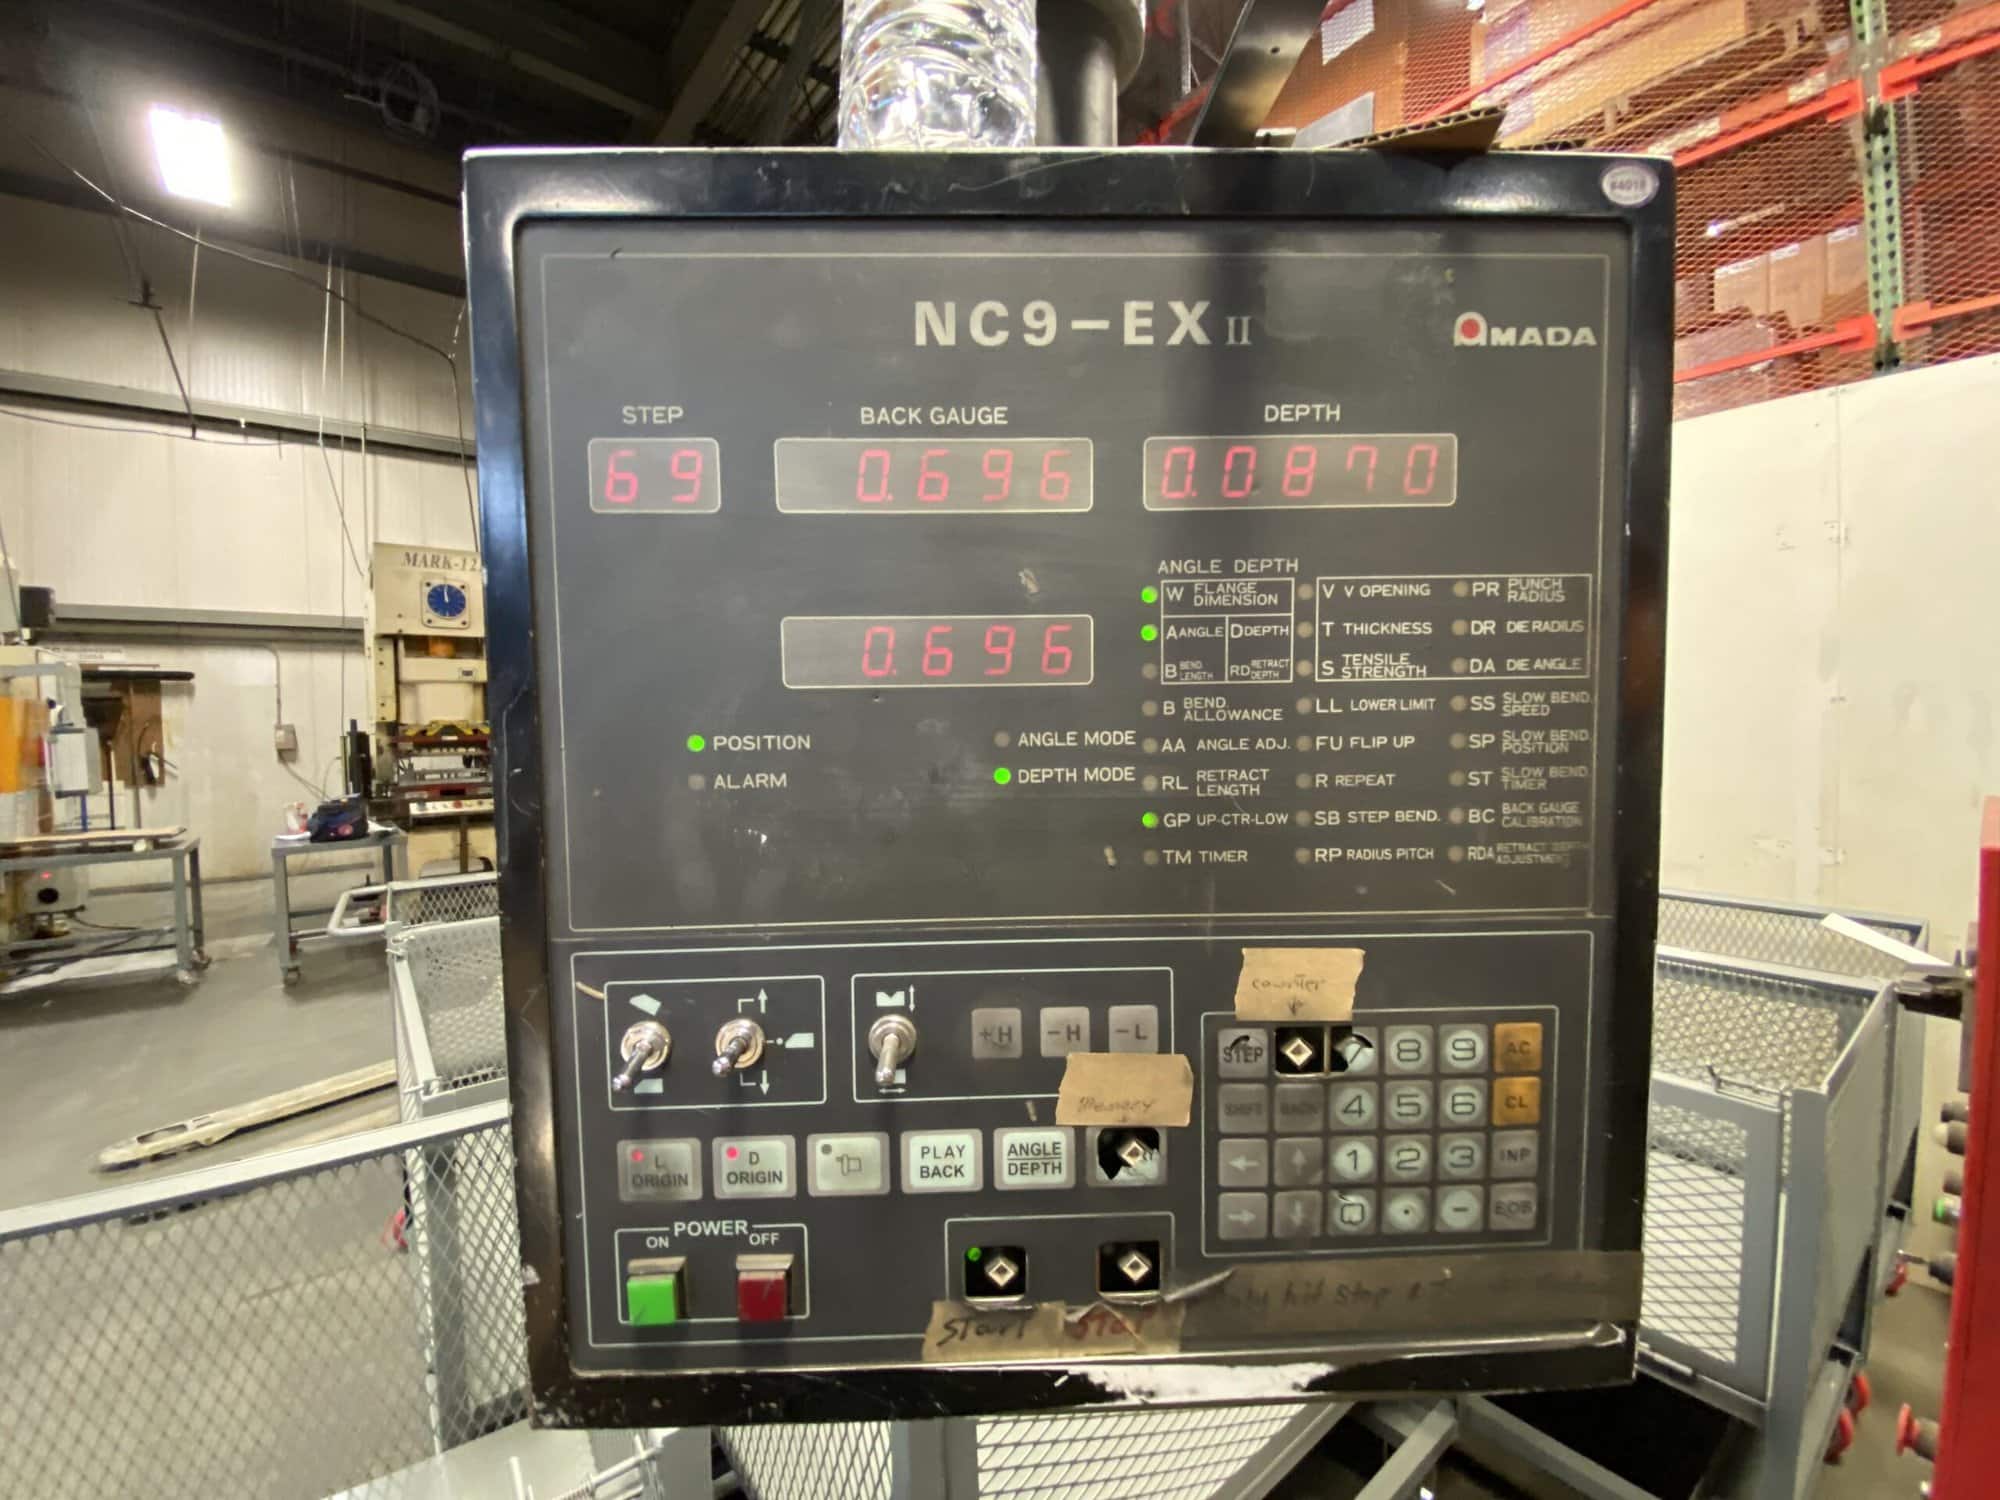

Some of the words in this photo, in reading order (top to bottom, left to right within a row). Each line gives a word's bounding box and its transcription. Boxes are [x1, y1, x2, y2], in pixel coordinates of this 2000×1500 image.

[1225, 316, 1252, 345] II
[1454, 311, 1597, 347] AMADA
[622, 405, 684, 424] STEP
[860, 406, 922, 425] BACK
[930, 406, 1008, 425] GAUGE
[1264, 403, 1341, 422] DEPTH
[605, 449, 703, 503] 69
[856, 448, 1072, 503] 0.696
[1161, 444, 1439, 498] 0.0870
[400, 551, 482, 572] MARK-12
[1158, 560, 1222, 574] ANGLE
[1234, 559, 1299, 573] DEPTH
[1166, 587, 1184, 601] W
[1194, 582, 1257, 594] FLANGE
[1322, 584, 1335, 599] V
[1360, 584, 1431, 598] OPENING
[1472, 582, 1500, 597] PR
[1508, 578, 1562, 590] PUNCH
[1194, 594, 1278, 606] DIMENSION
[1507, 590, 1565, 602] RADIUS
[1166, 625, 1178, 639] A
[1179, 626, 1224, 637] ANGLE
[1230, 624, 1243, 638] D
[1244, 625, 1289, 637] DEPTH
[1321, 622, 1335, 637] T
[1343, 622, 1433, 635] THICKNESS
[1471, 620, 1496, 635] DR
[1506, 621, 1529, 633] DIE
[1531, 620, 1584, 632] RADIUS
[861, 625, 1073, 677] 0.696
[1342, 653, 1411, 665] TENSILE
[1469, 659, 1496, 673] DA
[1506, 659, 1530, 671] DIE
[1533, 658, 1582, 670] ANGLE
[1165, 664, 1177, 679] B
[1180, 661, 1203, 670] BEND
[1230, 664, 1250, 677] RD
[1250, 659, 1290, 669] RETRACT
[1251, 670, 1279, 680] DEPTH
[1322, 660, 1334, 675] S
[1342, 665, 1427, 679] STRENGTH
[1180, 671, 1213, 681] LENGTH
[1163, 701, 1175, 715] B
[1184, 697, 1226, 709] BEND
[1316, 698, 1343, 713] LL
[1350, 698, 1396, 711] LOWER
[1400, 698, 1436, 711] LIMIT
[1470, 696, 1496, 711] SS
[1502, 692, 1546, 705] SLOW
[1184, 709, 1283, 721] ALLOWANCE
[1502, 705, 1550, 717] SPEED
[713, 735, 811, 751] POSITION
[1018, 732, 1078, 747] ANGLE
[1083, 730, 1137, 746] MODE
[1161, 738, 1186, 752] AA
[1196, 738, 1249, 750] ANGLE
[1255, 738, 1291, 750] ADJ.
[1315, 736, 1343, 751] FU
[1350, 736, 1388, 749] FLIP
[1393, 735, 1415, 748] UP
[1469, 734, 1496, 749] SP
[1502, 730, 1545, 742] SLOW
[1502, 742, 1569, 754] POSITION
[714, 773, 787, 789] ALARM
[1018, 768, 1077, 783] DEPTH
[1083, 767, 1136, 782] MODE
[1162, 776, 1188, 790] RL
[1197, 769, 1270, 782] RETRACT
[1315, 773, 1328, 788] R
[1335, 773, 1396, 787] REPEAT
[1468, 771, 1494, 786] ST
[1501, 767, 1544, 779] SLOW
[1197, 784, 1260, 797] LENGTH
[1501, 779, 1547, 791] TIMER
[1314, 811, 1340, 826] SB
[1347, 810, 1390, 823] STEP
[1468, 809, 1495, 823] BC
[1502, 802, 1534, 815] BACK
[1539, 801, 1580, 814] GAUGE
[1163, 813, 1191, 828] GP
[1502, 816, 1582, 828] CALIBRATION
[1163, 849, 1192, 864] TM
[1199, 850, 1248, 863] TIMER
[1315, 848, 1342, 863] RP
[1347, 849, 1392, 861] RADIUS
[1396, 848, 1434, 860] PITCH
[1468, 846, 1495, 860] RDA
[1223, 1045, 1263, 1063] STEP
[1397, 1039, 1421, 1062] 8
[1452, 1038, 1476, 1061] 9
[1506, 1041, 1530, 1056] AC
[1342, 1095, 1364, 1117] 4
[1397, 1094, 1421, 1116] 5
[1451, 1092, 1476, 1115] 6
[1505, 1095, 1528, 1109] CL
[921, 1145, 965, 1159] PLAY
[1008, 1142, 1061, 1157] ANGLE
[1450, 1146, 1474, 1168] 3
[654, 1155, 664, 1169] L
[749, 1151, 759, 1165] D
[1346, 1149, 1358, 1170] 1
[1396, 1148, 1420, 1170] 2
[920, 1164, 965, 1179] BACK
[1008, 1161, 1062, 1176] DEPTH
[631, 1173, 688, 1188] ORIGIN
[727, 1171, 783, 1185] ORIGIN
[674, 1220, 748, 1237] POWER
[646, 1236, 669, 1249] ON
[749, 1232, 780, 1246] OFF
